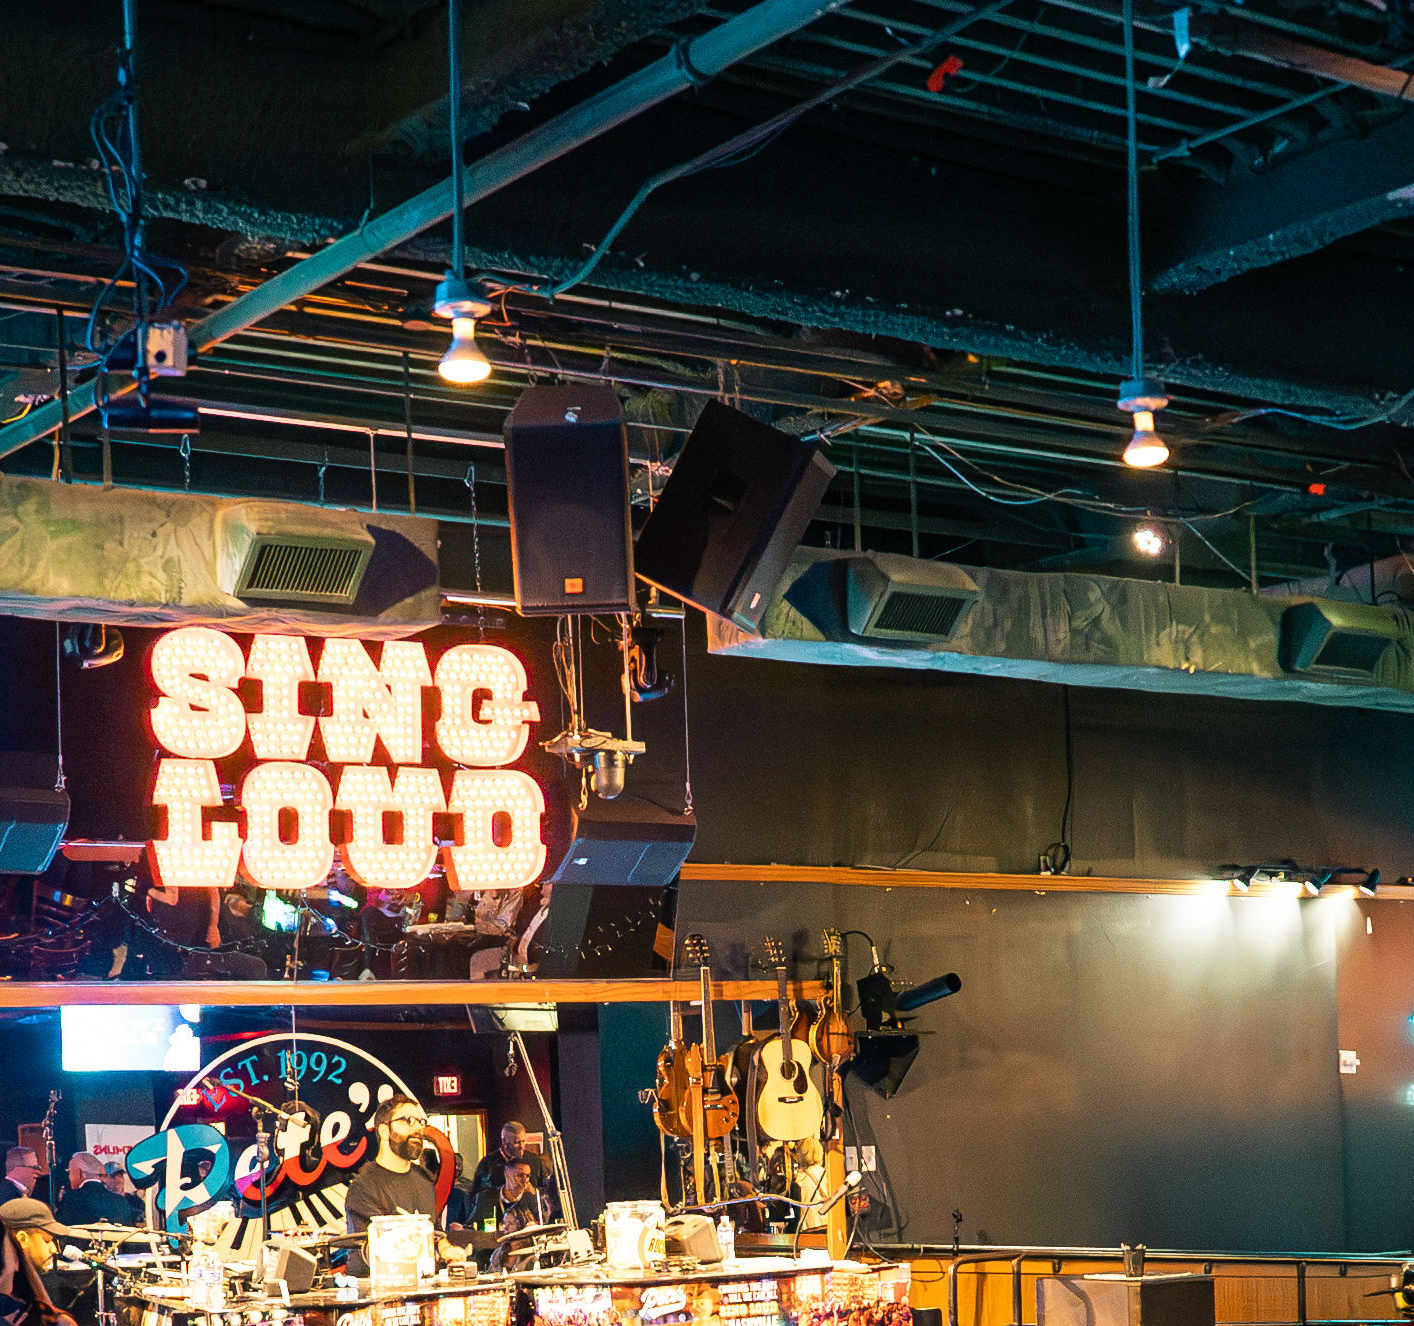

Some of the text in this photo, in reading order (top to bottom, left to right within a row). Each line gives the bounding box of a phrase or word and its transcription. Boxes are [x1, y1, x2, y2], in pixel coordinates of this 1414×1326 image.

[150, 627, 541, 767] SING
[147, 759, 547, 890] LOUD
[201, 1050, 347, 1113] EST. 1992
[719, 1301, 779, 1317] SING LOUD
